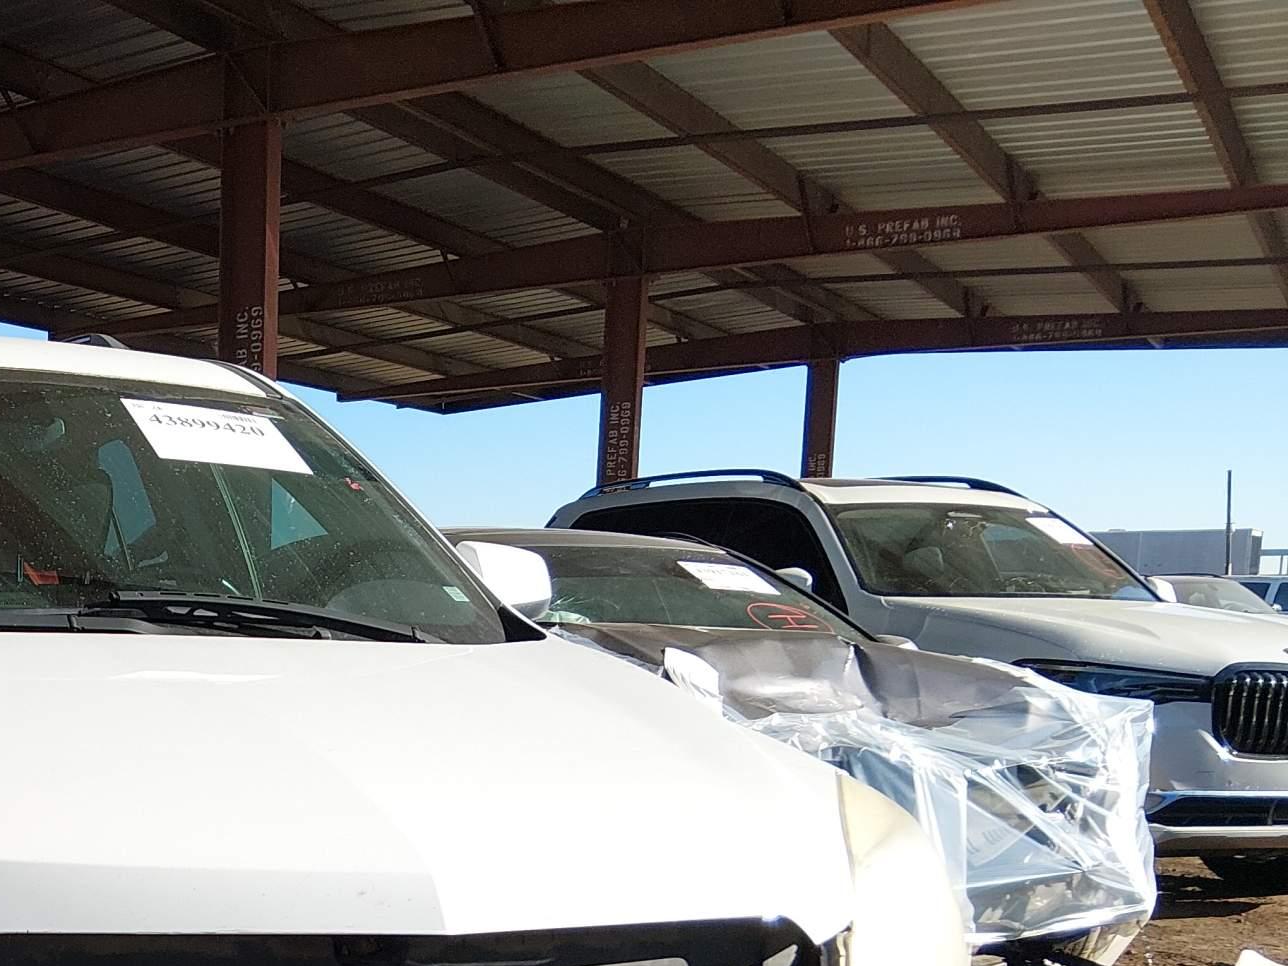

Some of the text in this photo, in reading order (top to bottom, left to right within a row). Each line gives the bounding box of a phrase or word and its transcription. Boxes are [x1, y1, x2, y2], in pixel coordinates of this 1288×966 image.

[236, 306, 249, 339] INC.
[148, 413, 266, 437] 43899420
[606, 401, 621, 476] PREFAB INC.
